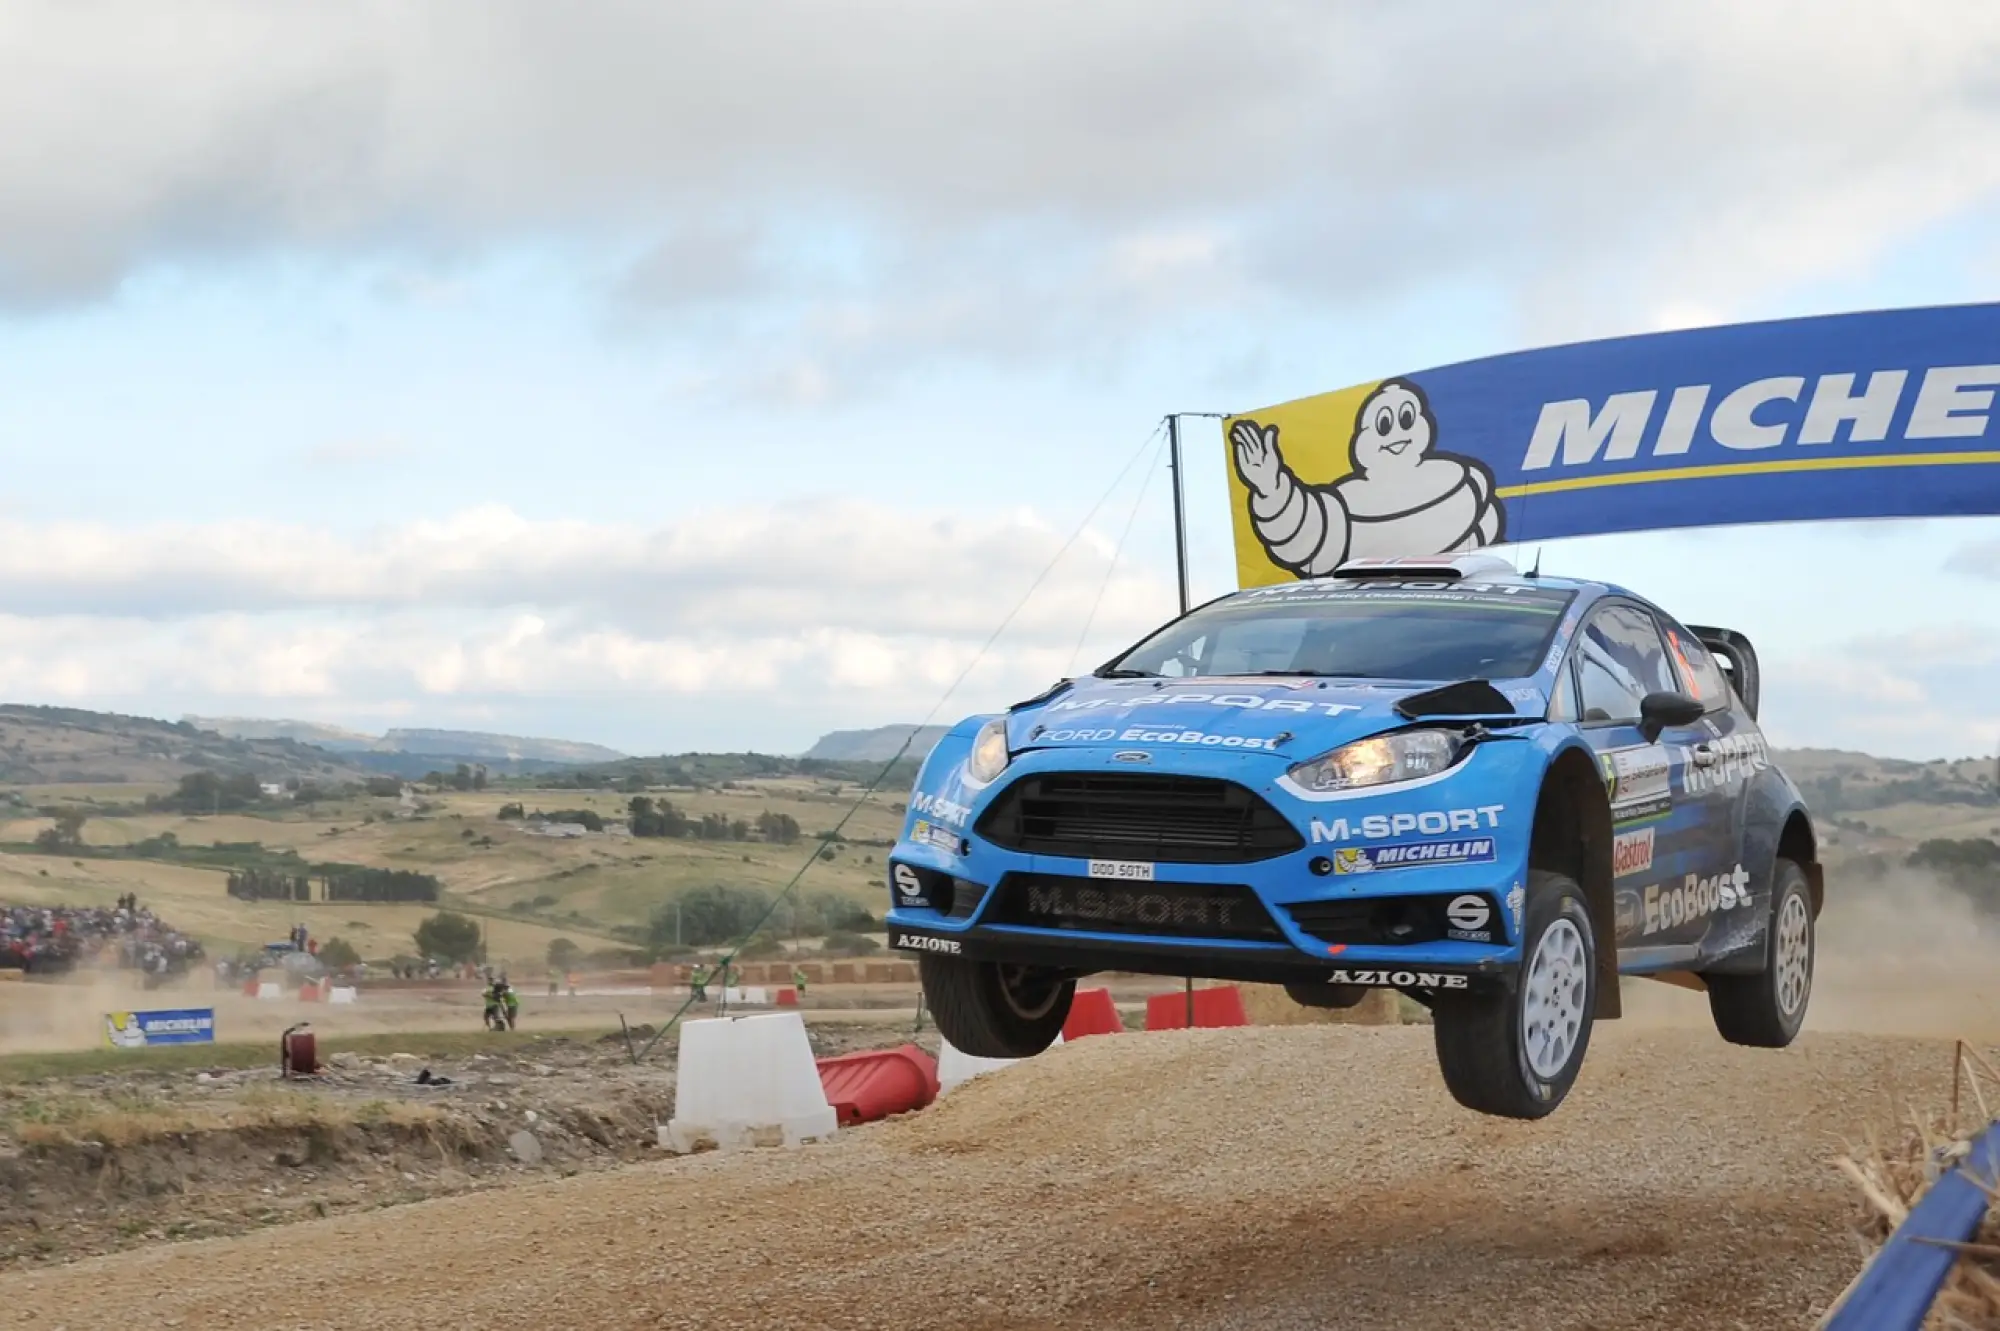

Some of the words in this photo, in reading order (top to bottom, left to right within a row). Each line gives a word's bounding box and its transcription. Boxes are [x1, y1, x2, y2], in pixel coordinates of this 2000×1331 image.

[1521, 364, 2000, 471] MICHE
[1047, 694, 1362, 717] M-SPORT
[1034, 728, 1117, 743] FORD
[1118, 729, 1279, 751] EcoBoost
[1309, 804, 1505, 844] M-SPORT
[1376, 841, 1491, 864] MICHELIN
[1614, 833, 1652, 874] Castrol
[1642, 863, 1753, 936] EcoBoost
[897, 933, 962, 955] AZIONE
[1327, 969, 1468, 990] AZIONE
